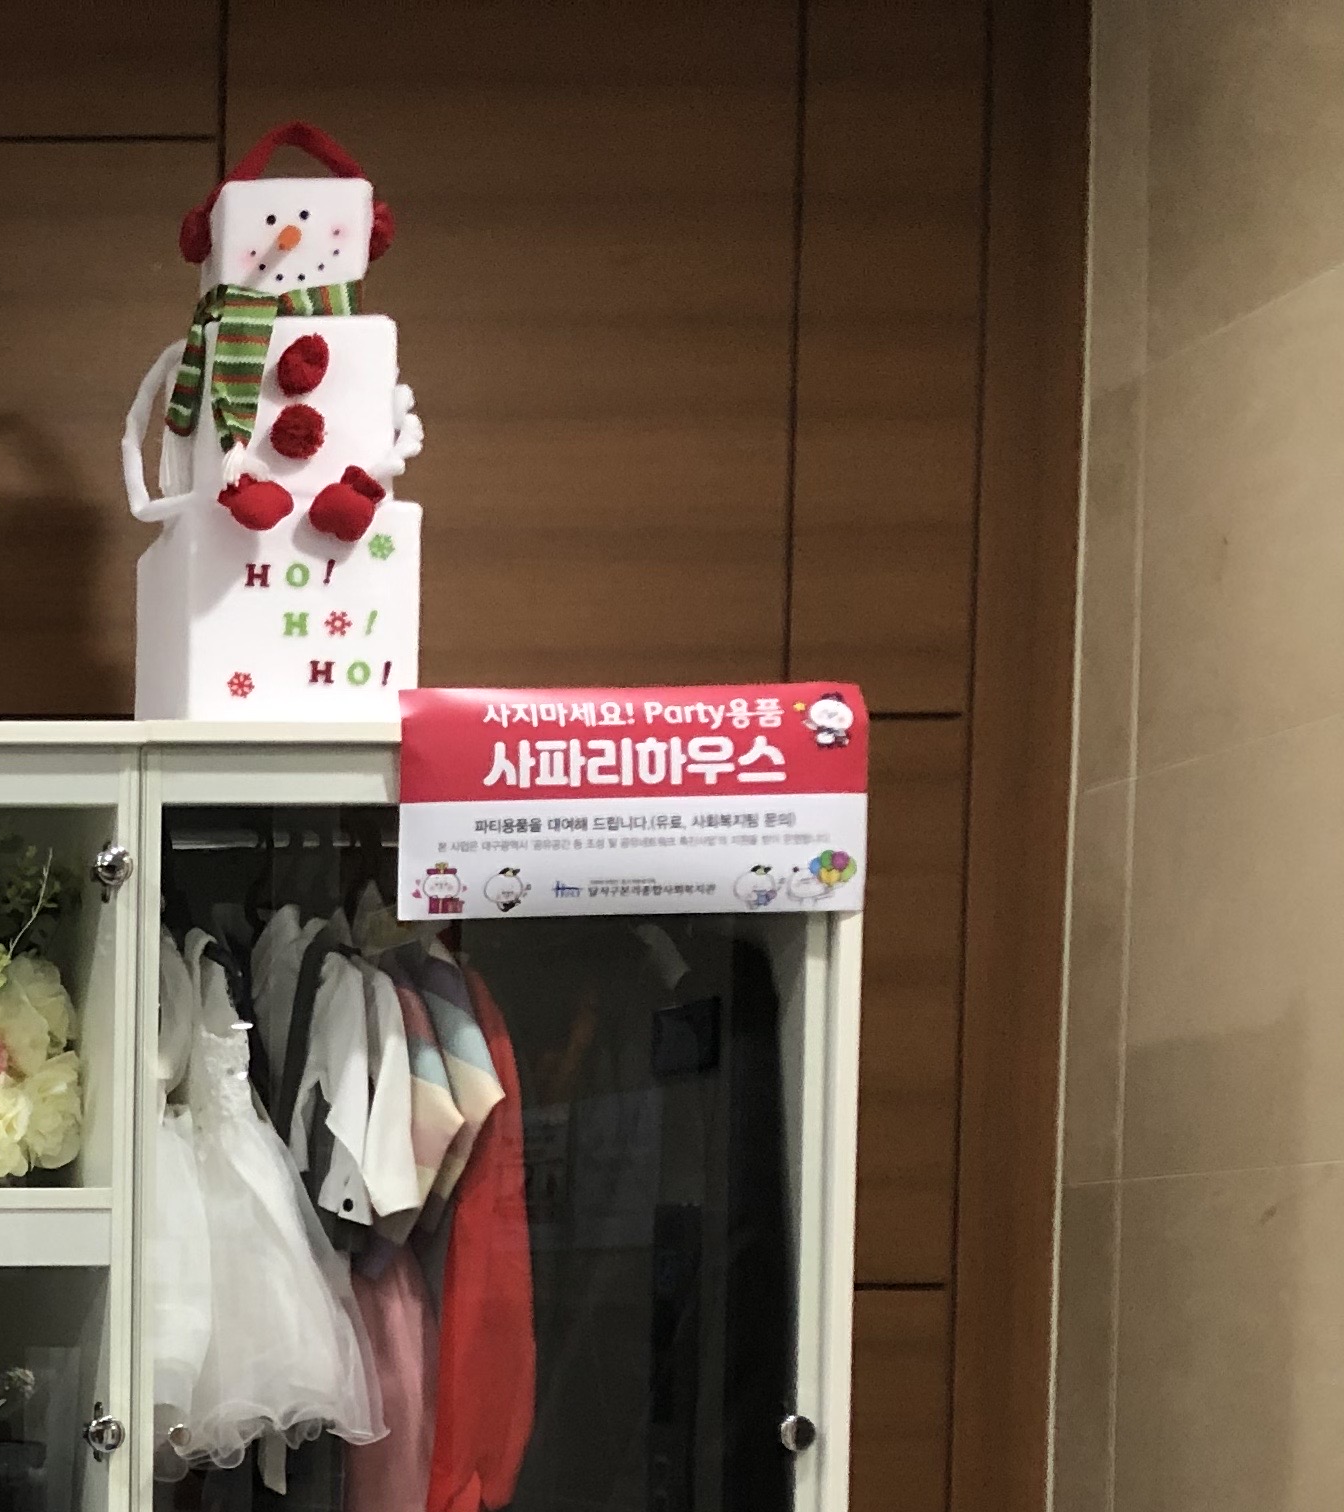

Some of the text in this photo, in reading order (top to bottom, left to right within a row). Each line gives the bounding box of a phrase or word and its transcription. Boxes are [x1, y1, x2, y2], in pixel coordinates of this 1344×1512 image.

[245, 559, 336, 588] HO!
[308, 660, 392, 686] HO!
[482, 697, 785, 730] 사지마세요! Party용품
[483, 735, 787, 788] 사파리하우스
[475, 817, 542, 834] 파티용품을
[547, 817, 588, 832] 대여해
